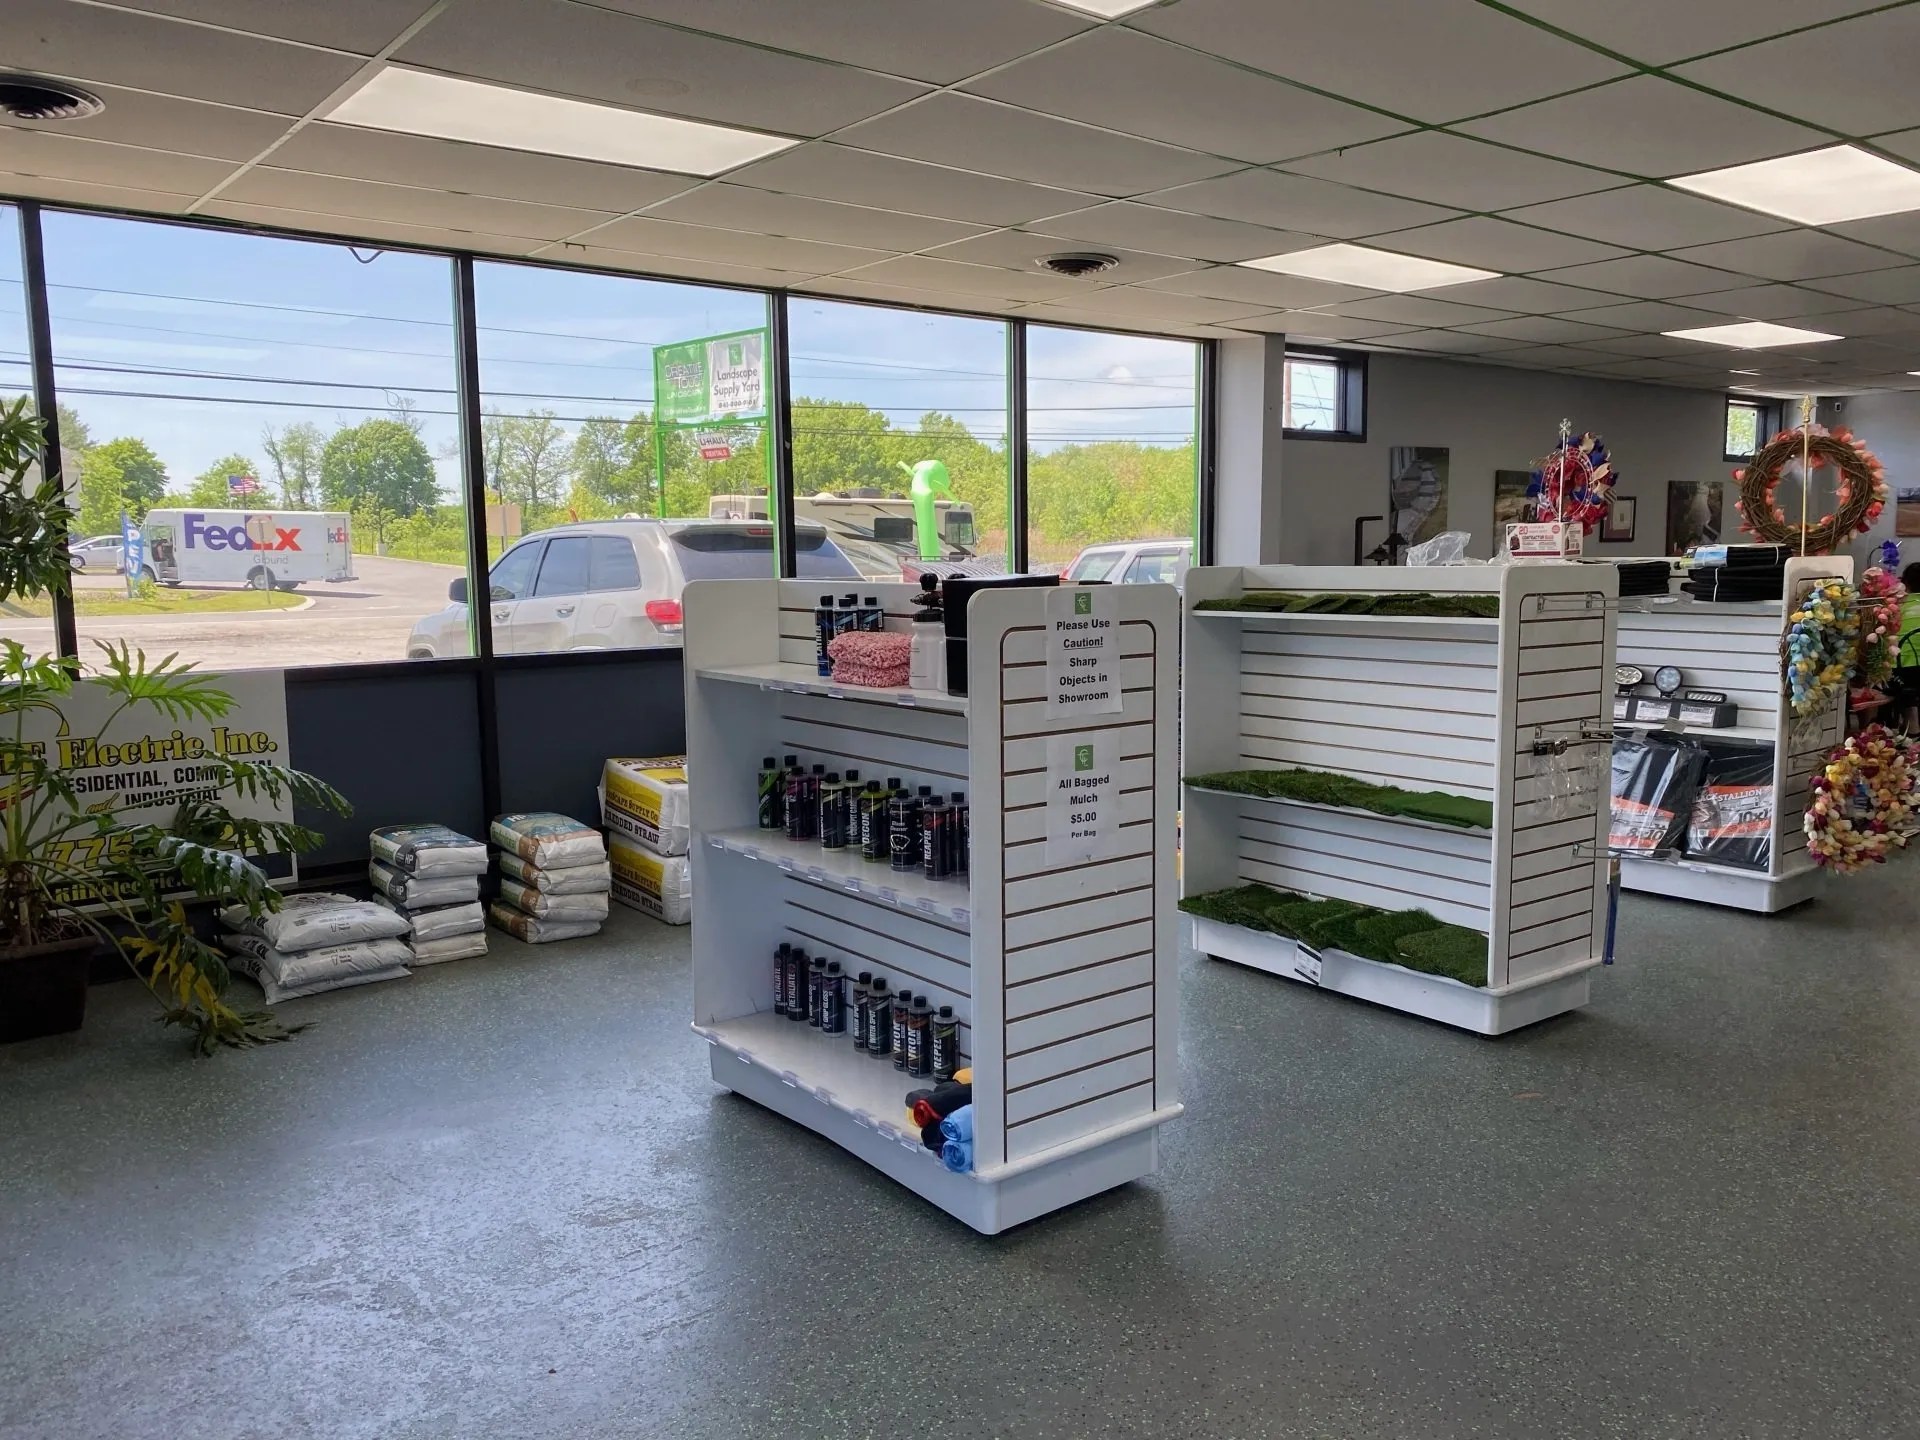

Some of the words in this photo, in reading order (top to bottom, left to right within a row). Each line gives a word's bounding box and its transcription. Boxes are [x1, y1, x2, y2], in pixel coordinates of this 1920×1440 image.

[717, 368, 758, 380] Landscape
[713, 382, 740, 398] Supply
[742, 378, 760, 392] Yard
[1056, 621, 1088, 631] Please
[1091, 619, 1110, 629] Use
[1063, 636, 1103, 649] Caution!
[1069, 657, 1097, 667] Sharp
[1060, 675, 1096, 687] Objects
[1099, 673, 1107, 682] in
[1059, 692, 1109, 703] Showroom
[56, 730, 204, 770] Electric
[211, 726, 278, 756] Inc.
[66, 769, 168, 794] ESIDENTIAL,
[1059, 779, 1071, 789] All
[1075, 775, 1110, 788] Bagged
[1070, 794, 1098, 805] Mulch
[1718, 788, 1762, 802] STALLION
[1070, 812, 1097, 824] $5.00
[862, 812, 870, 843] DECON
[933, 1038, 942, 1069] REPEL
